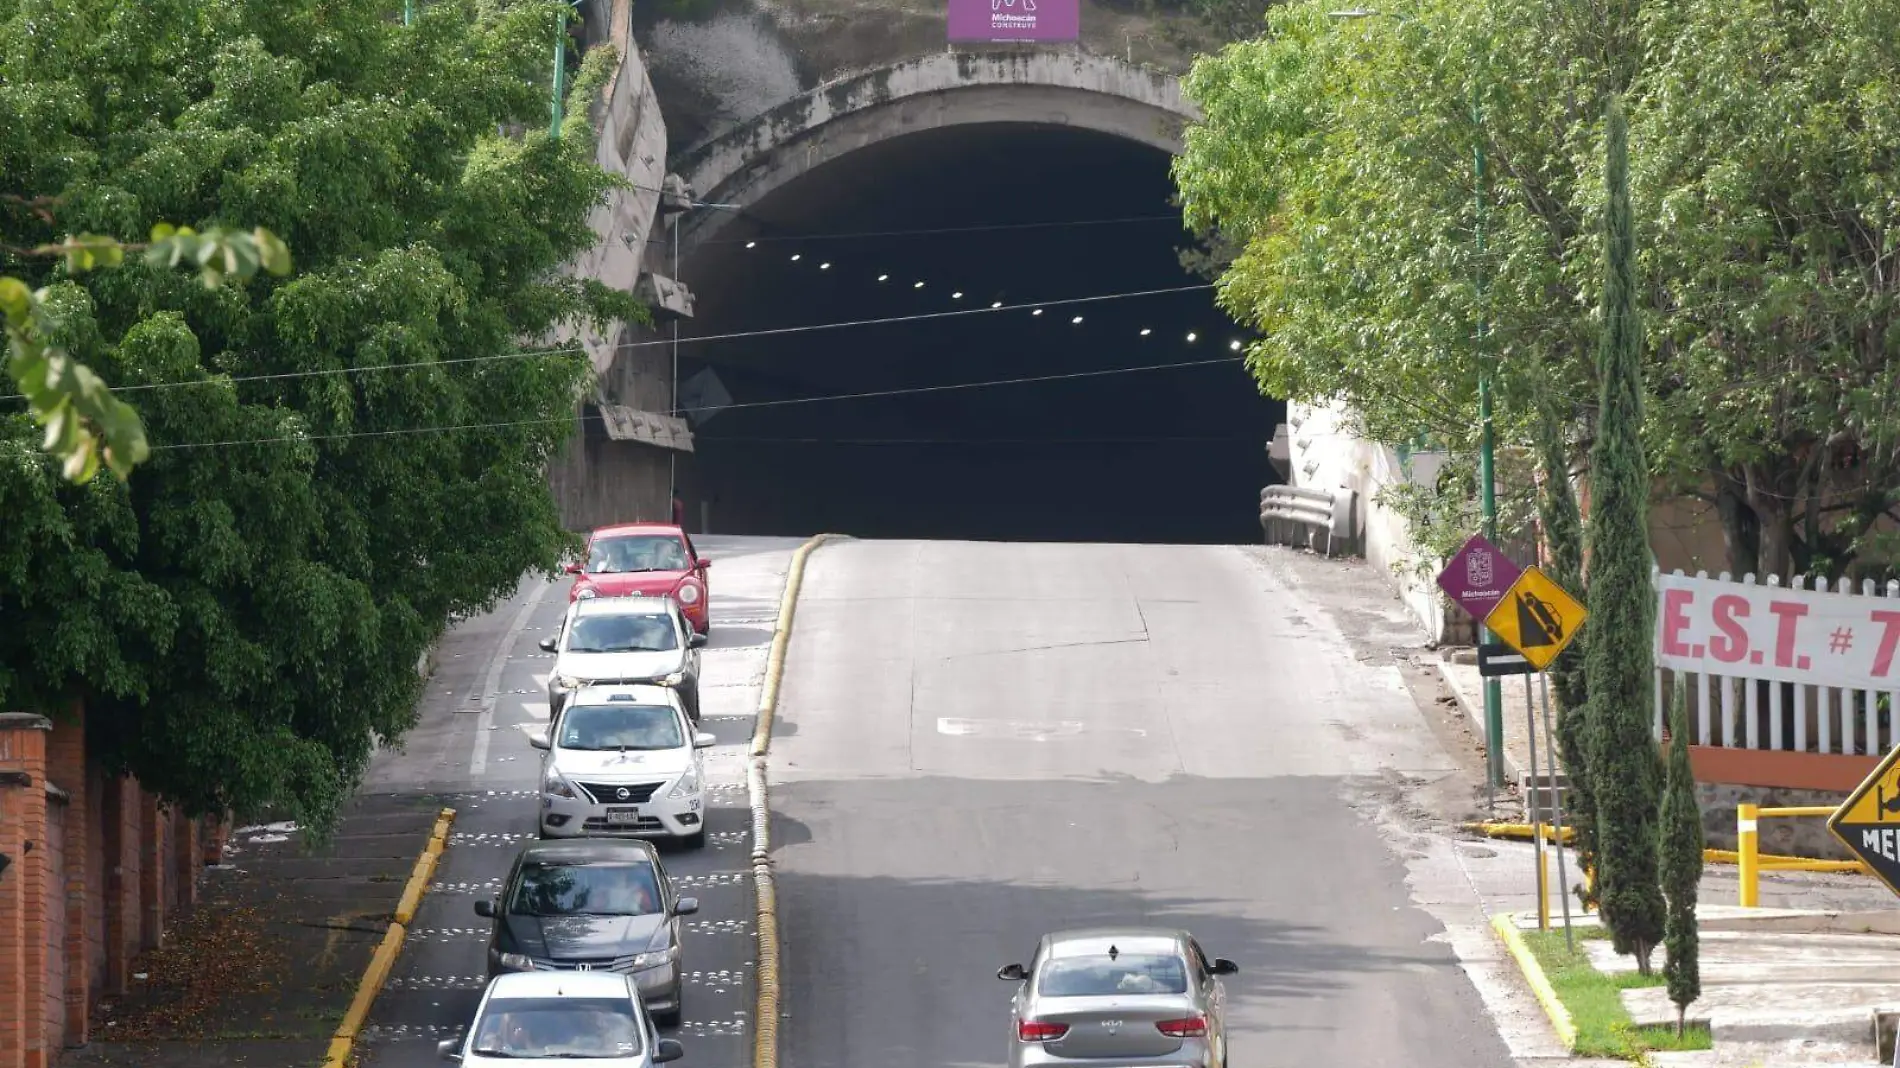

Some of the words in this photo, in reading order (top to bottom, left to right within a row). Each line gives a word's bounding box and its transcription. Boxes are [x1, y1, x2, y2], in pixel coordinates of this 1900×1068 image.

[992, 13, 1036, 21] Michoacán
[1662, 589, 1811, 670] E.S.T.
[1829, 625, 1854, 656] #
[1862, 829, 1900, 863] ME
